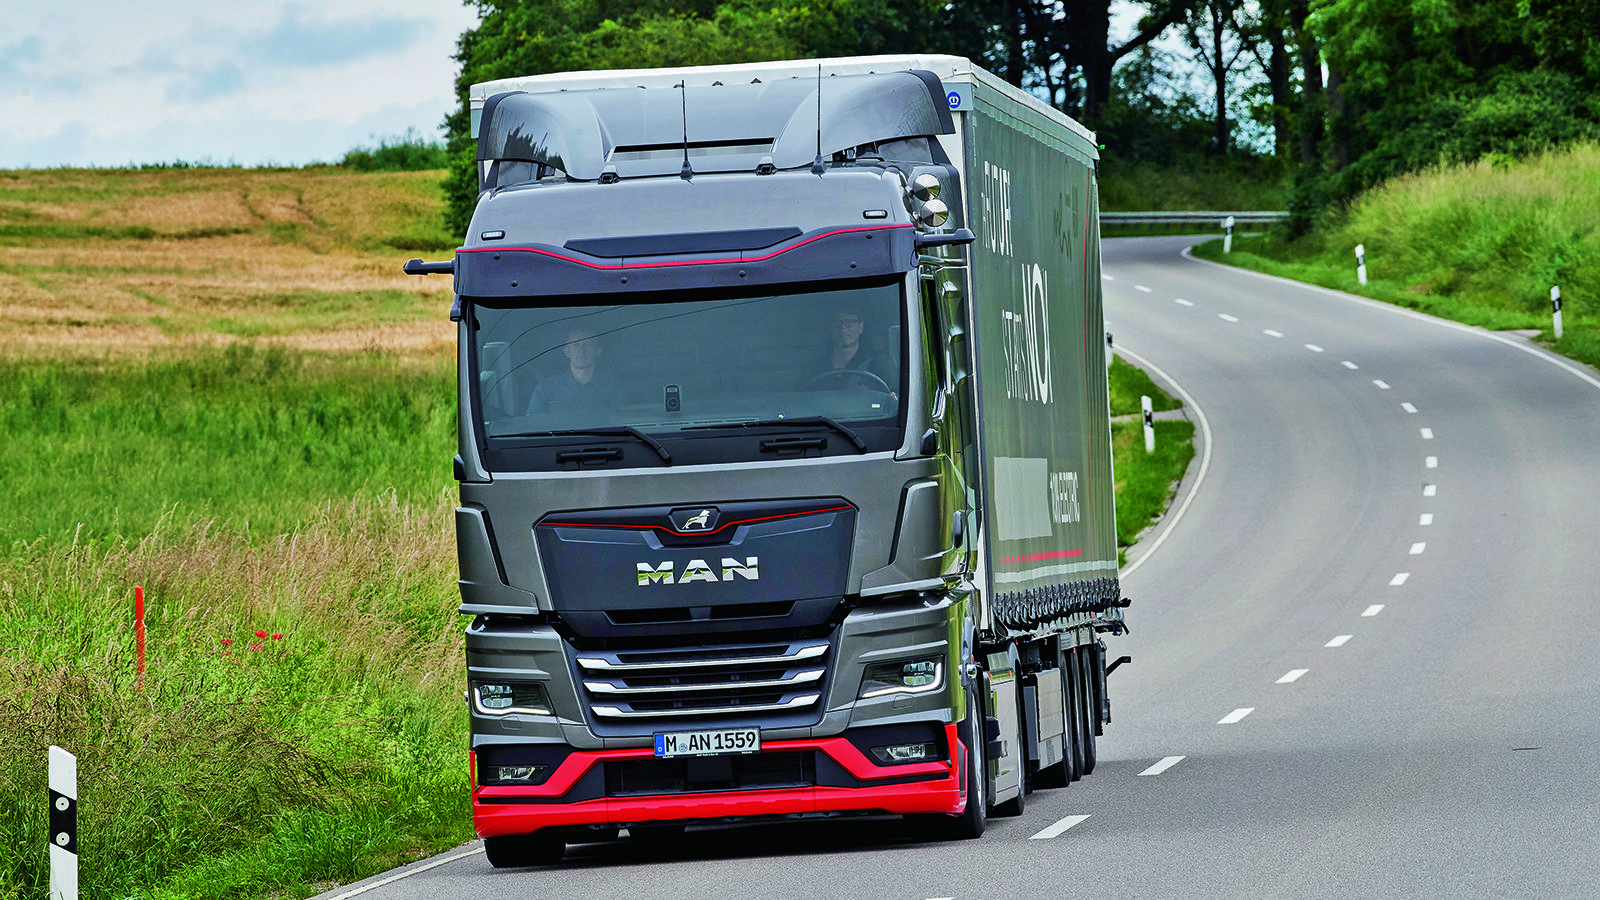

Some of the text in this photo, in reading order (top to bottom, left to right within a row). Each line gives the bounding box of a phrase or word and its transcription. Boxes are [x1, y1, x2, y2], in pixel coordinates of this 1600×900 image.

[636, 556, 760, 586] MAN
[665, 731, 756, 752] M AN 1559
